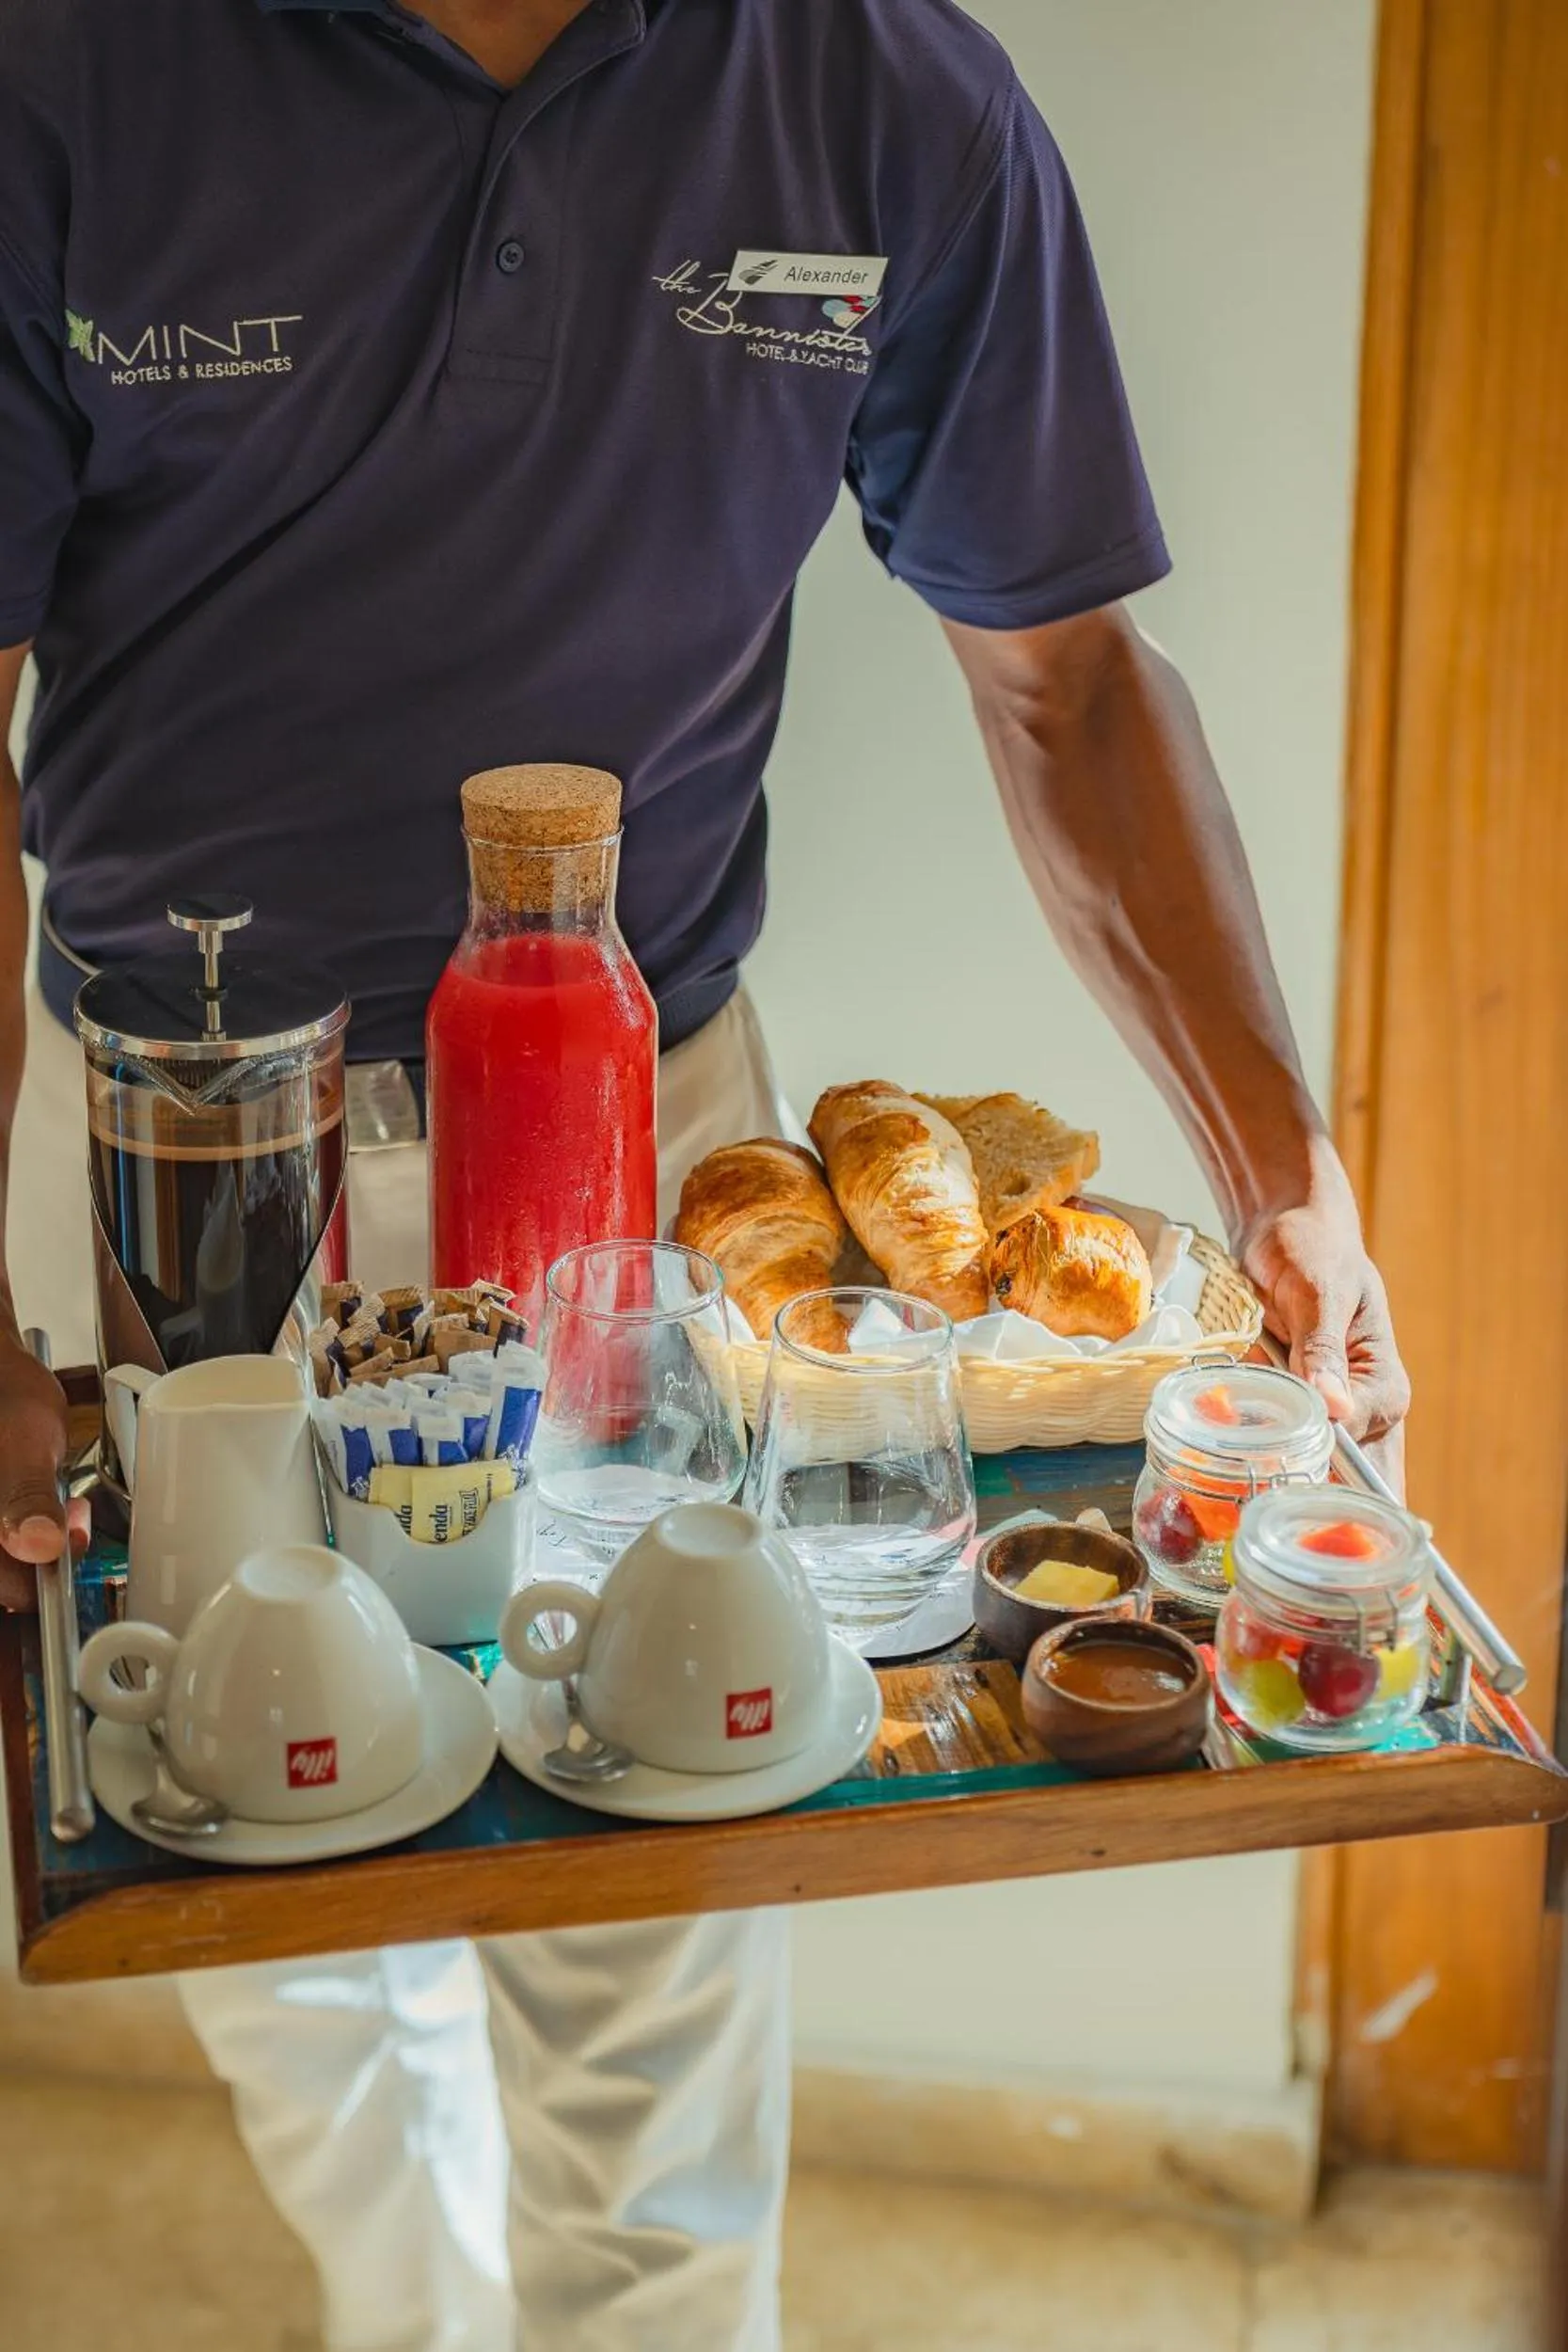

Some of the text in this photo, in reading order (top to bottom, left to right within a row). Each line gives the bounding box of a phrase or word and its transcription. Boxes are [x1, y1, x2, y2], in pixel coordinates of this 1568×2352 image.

[784, 265, 869, 284] Alexander
[97, 314, 303, 367] MINT
[110, 356, 293, 386] HOTELS & RESIDENCES
[728, 1699, 770, 1732] illy
[291, 1748, 335, 1781] illy
